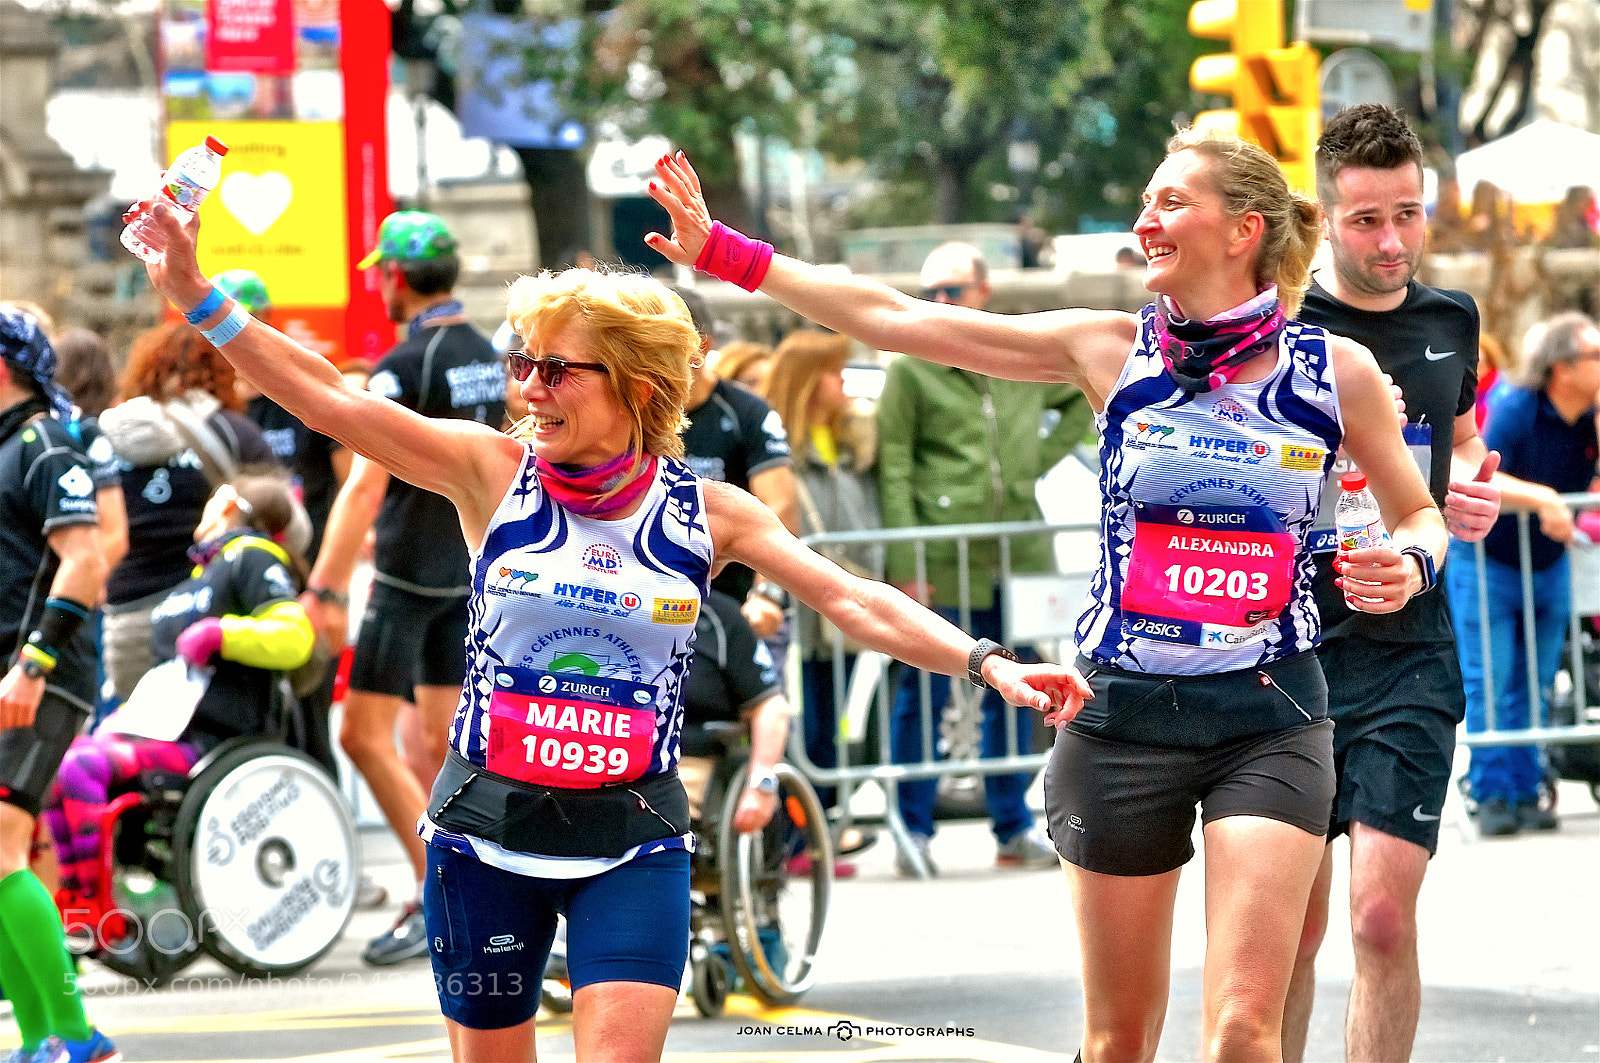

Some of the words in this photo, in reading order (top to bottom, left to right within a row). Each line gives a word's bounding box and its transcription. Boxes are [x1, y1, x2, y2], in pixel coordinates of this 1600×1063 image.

[1218, 409, 1243, 422] MD
[1189, 435, 1248, 454] HYPER
[1198, 513, 1246, 524] ZURICH
[591, 548, 617, 561] EURL
[1167, 535, 1275, 558] ALEXANDRA
[588, 556, 617, 569] MD
[1164, 563, 1270, 601] 10203
[553, 582, 618, 606] HYPER
[1144, 621, 1182, 638] asics
[531, 626, 601, 653] CÉVENNES
[561, 681, 610, 697] ZURICH
[525, 702, 632, 738] MARIE
[521, 734, 629, 776] 10939
